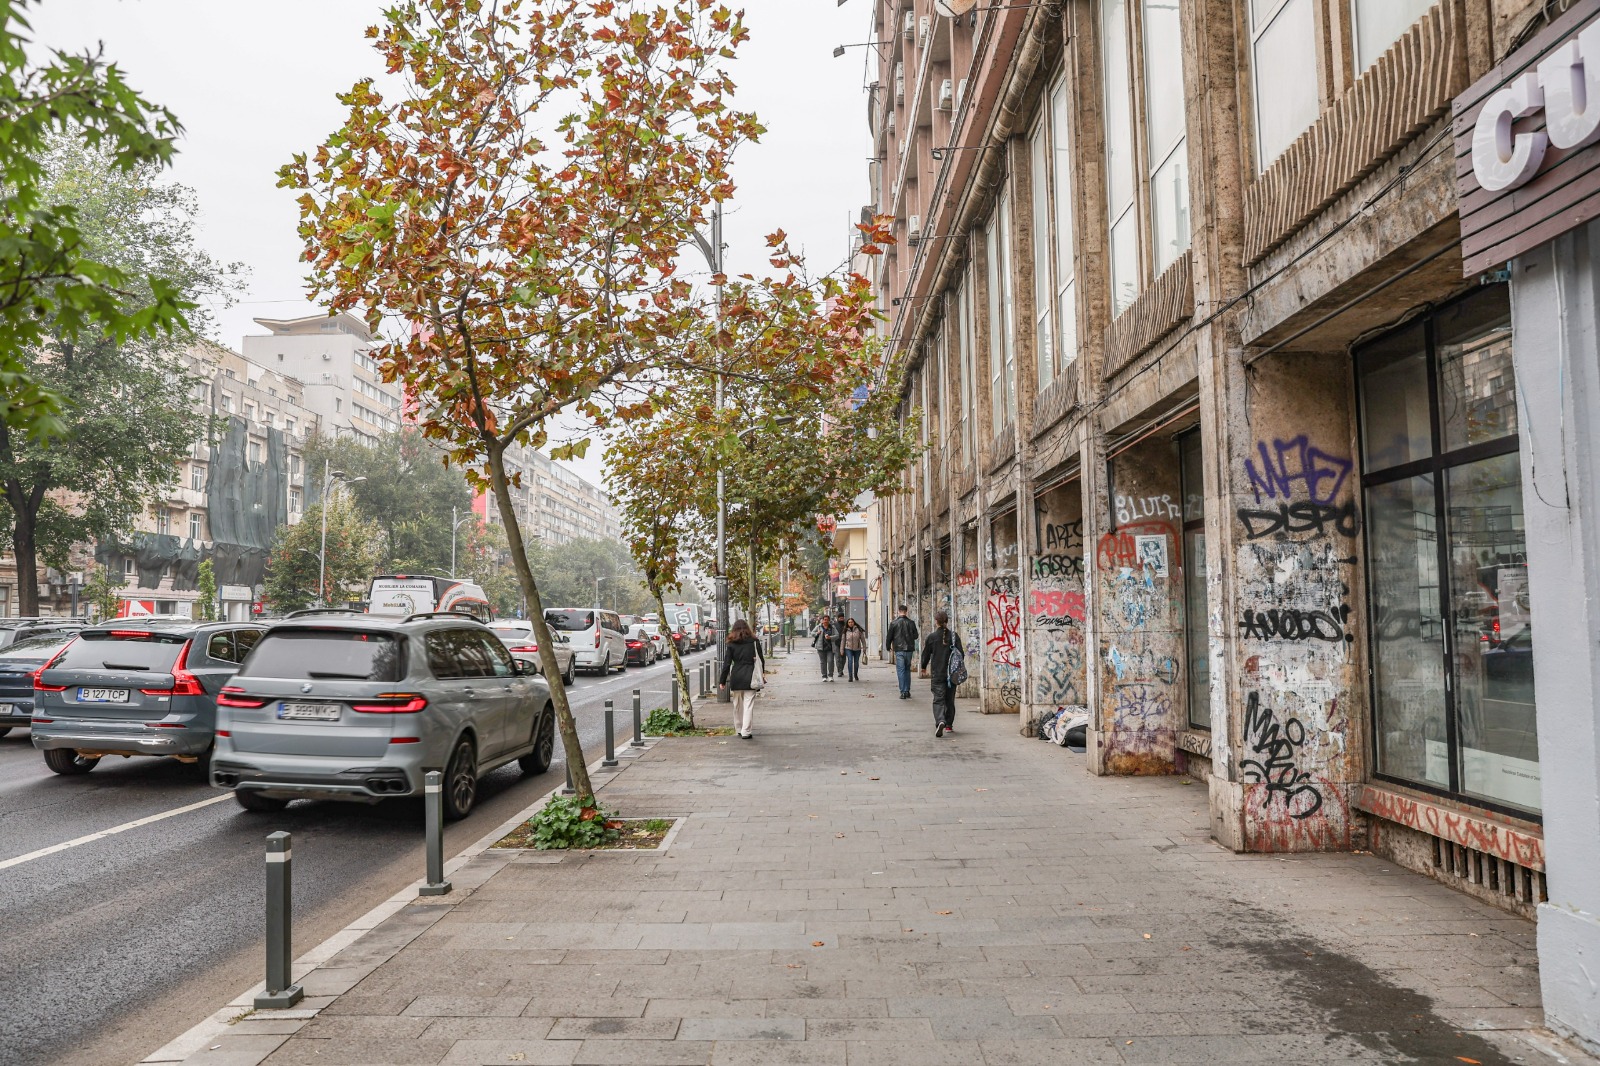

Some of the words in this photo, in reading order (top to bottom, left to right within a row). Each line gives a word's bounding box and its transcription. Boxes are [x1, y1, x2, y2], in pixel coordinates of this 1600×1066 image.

[83, 689, 89, 698] B
[92, 689, 106, 699] 127
[108, 690, 126, 699] TCP
